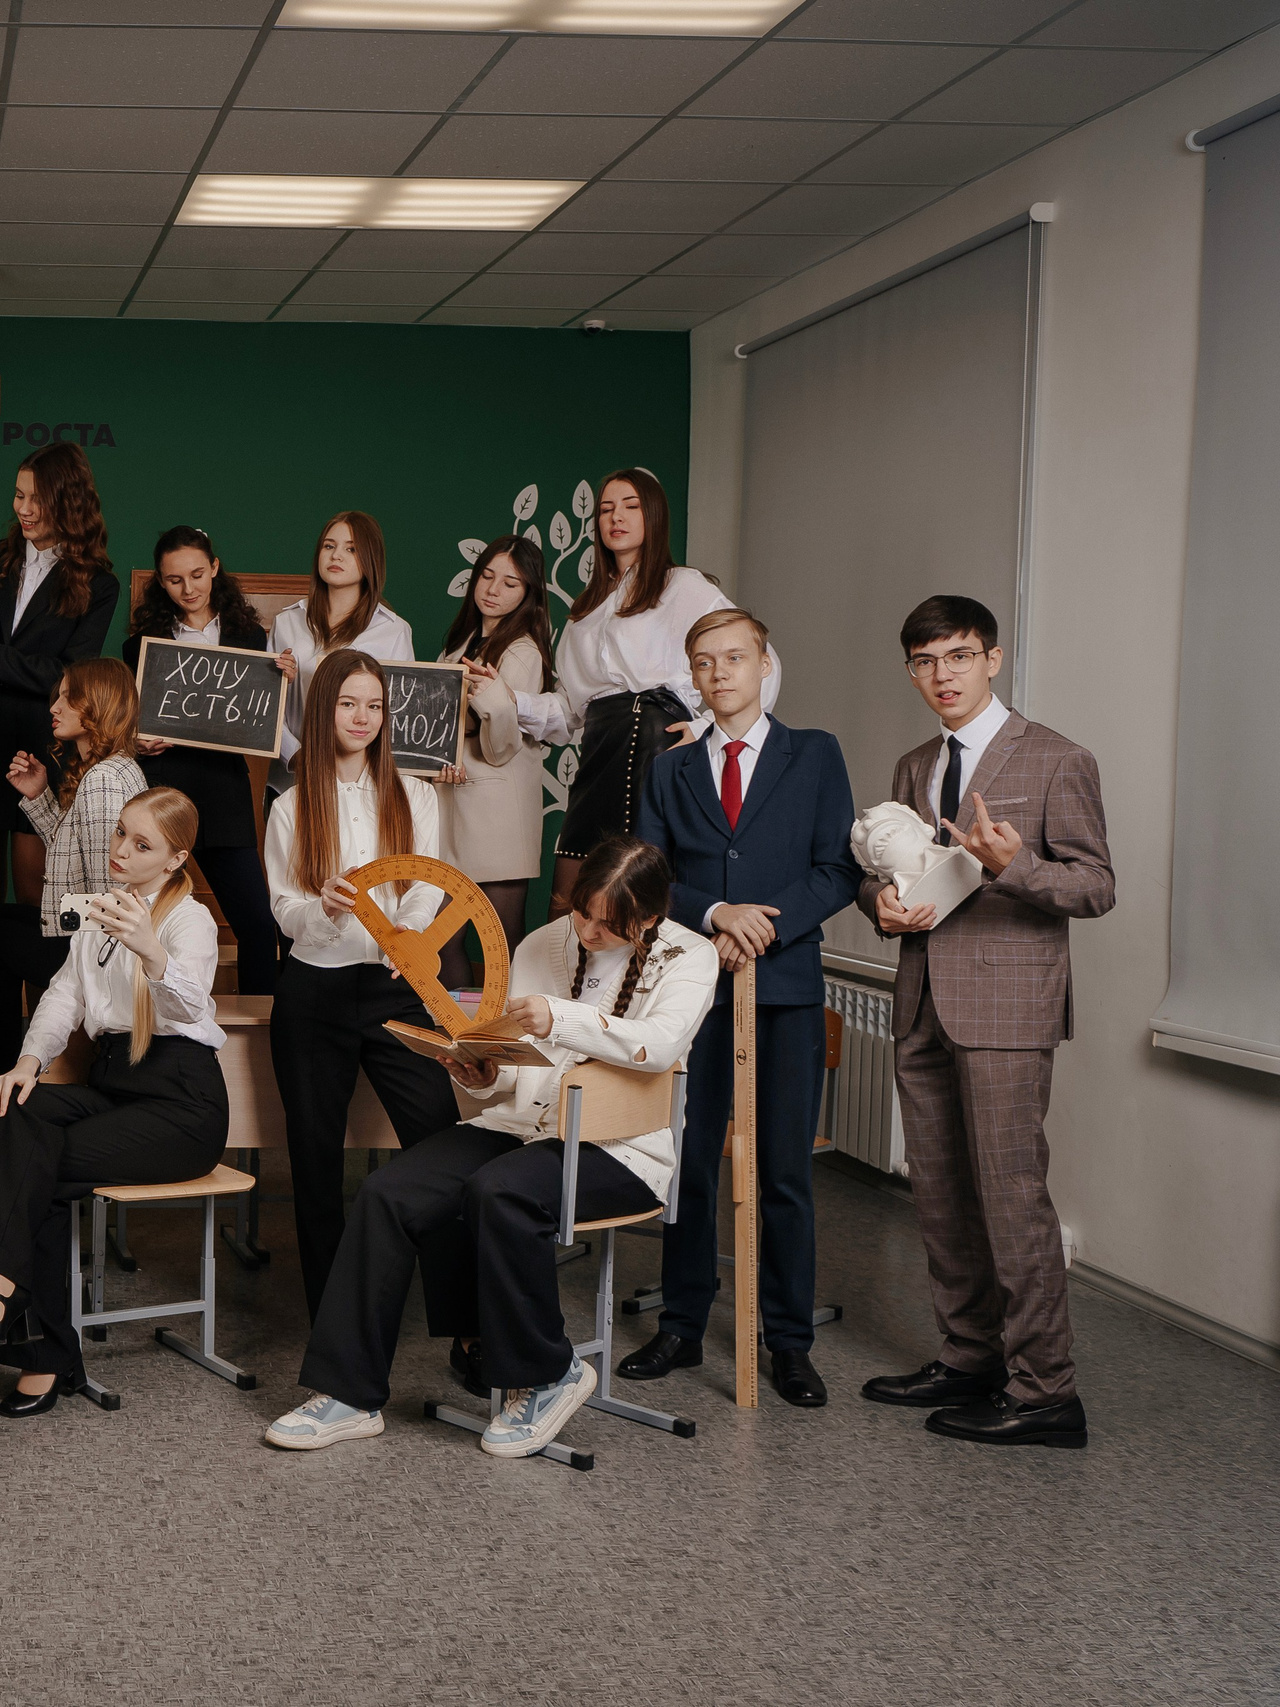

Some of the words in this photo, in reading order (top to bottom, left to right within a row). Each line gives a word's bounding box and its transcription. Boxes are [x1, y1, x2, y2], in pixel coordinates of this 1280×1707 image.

[2, 421, 117, 448] РОСТА
[164, 651, 250, 690] ХОЧУ
[157, 688, 272, 727] ЕСТЬ!!!
[362, 910, 370, 918] 40
[417, 978, 426, 988] 20
[431, 996, 439, 1005] 15
[446, 1014, 454, 1022] 10
